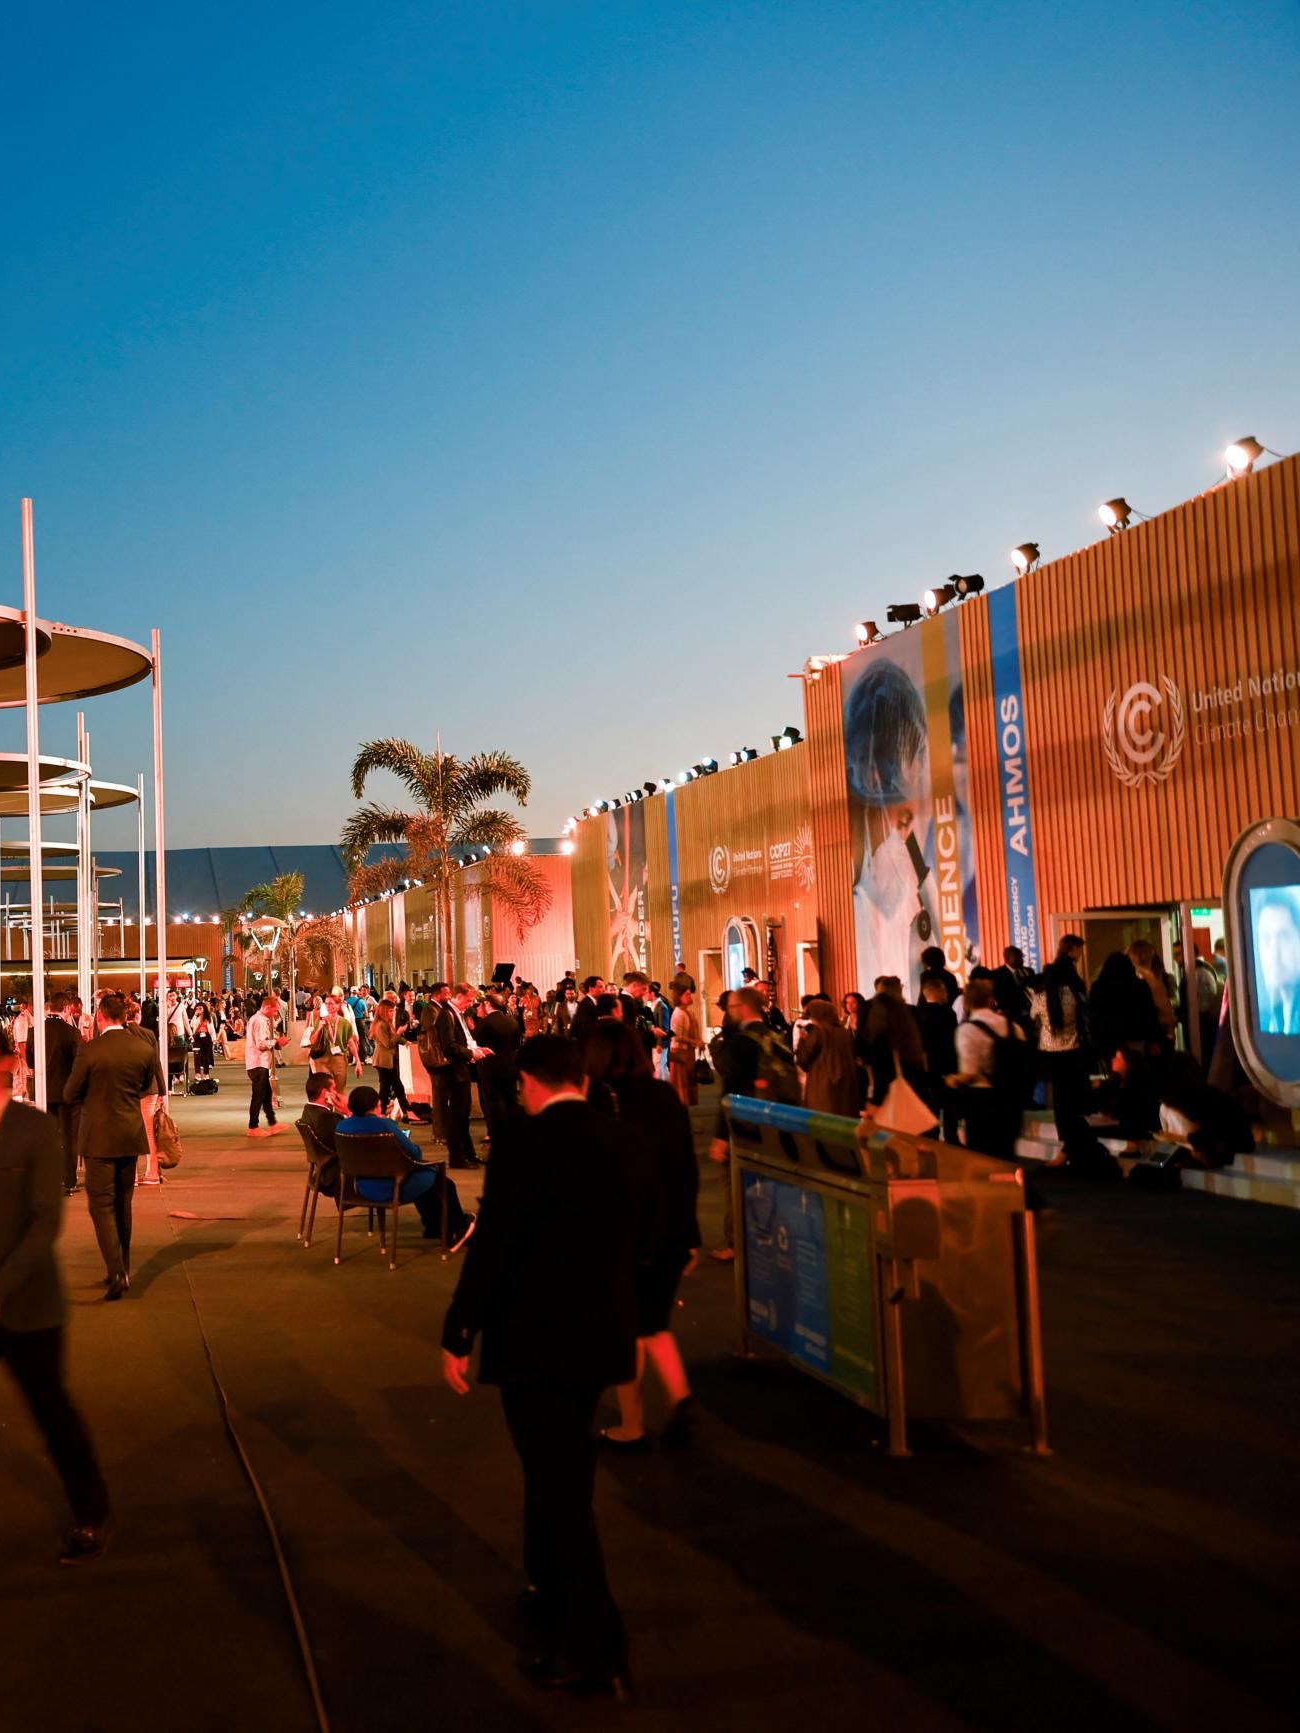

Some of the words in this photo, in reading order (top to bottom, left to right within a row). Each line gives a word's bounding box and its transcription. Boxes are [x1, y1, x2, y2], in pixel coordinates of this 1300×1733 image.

[1193, 680, 1243, 712] United
[1195, 718, 1251, 745] Climate
[1000, 694, 1028, 857] AHMOS
[638, 891, 646, 974] ENDER
[671, 885, 681, 967] KHUFU
[1011, 876, 1021, 949] ESIDENCY
[1026, 905, 1036, 948] ROOM
